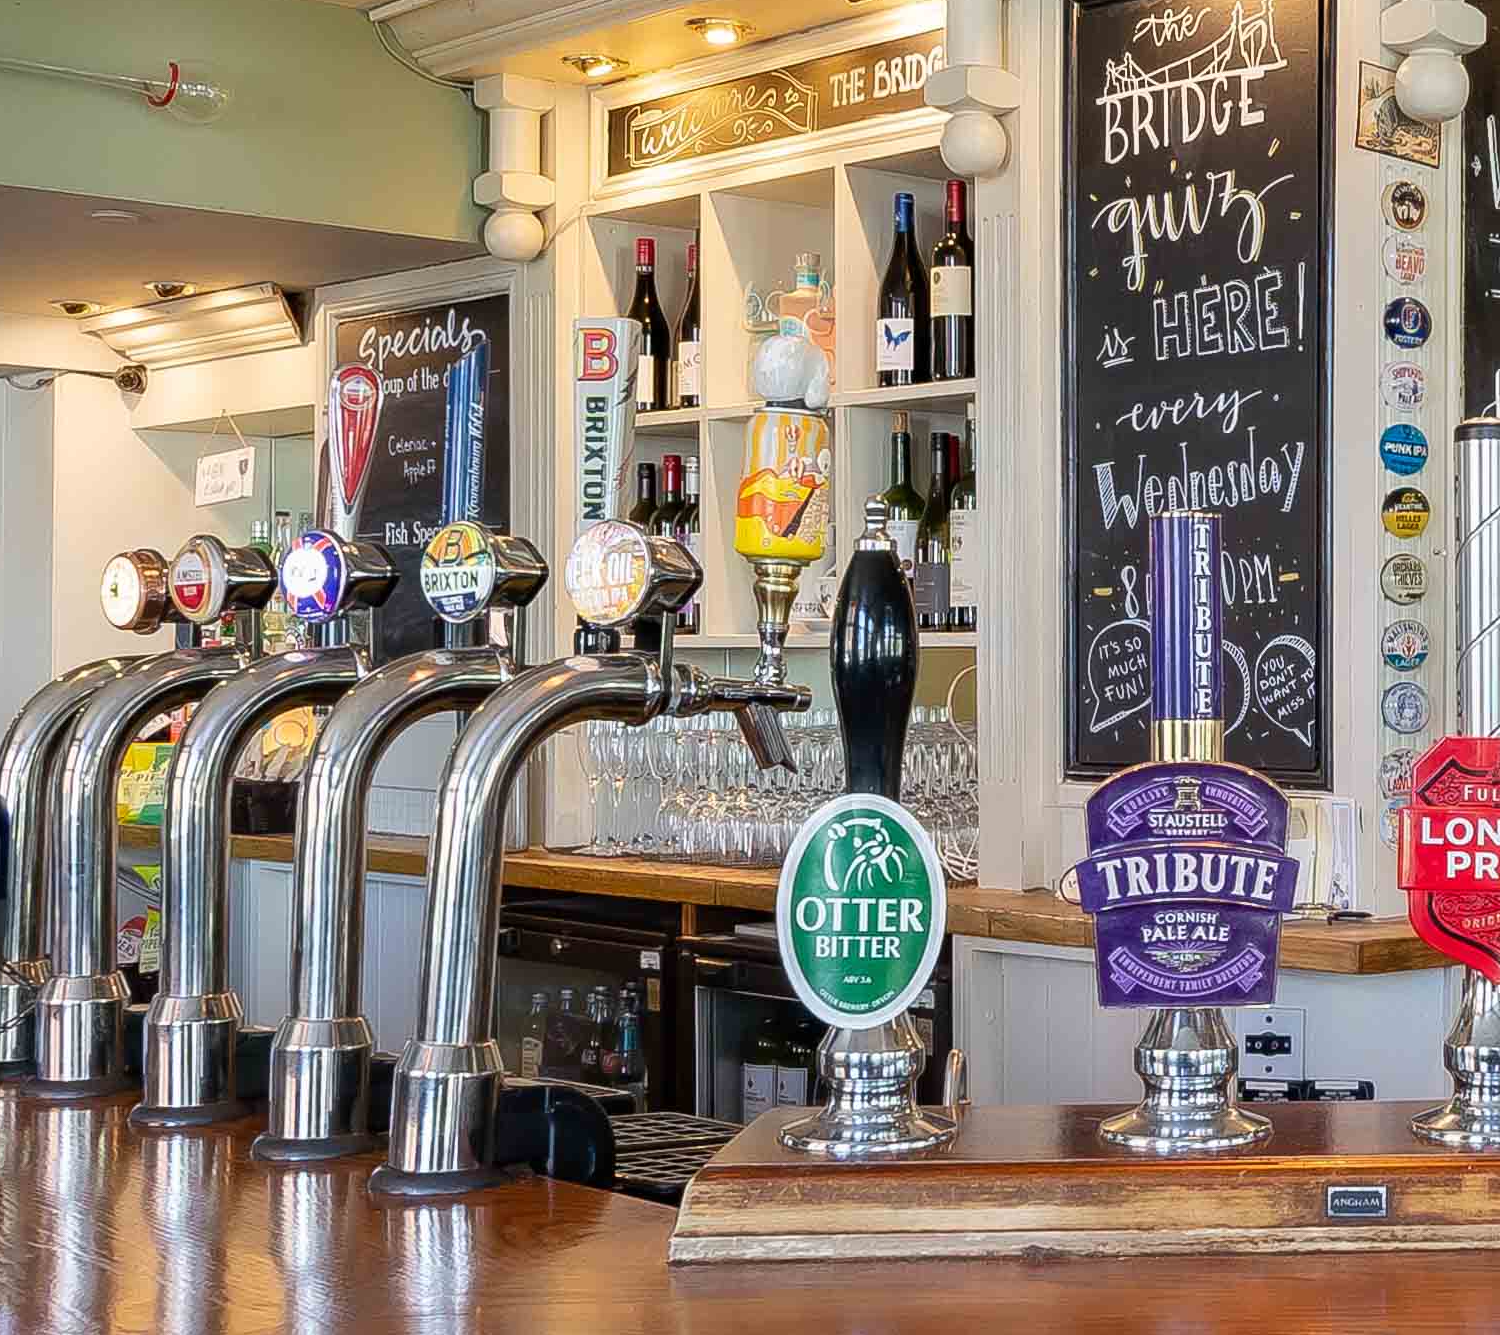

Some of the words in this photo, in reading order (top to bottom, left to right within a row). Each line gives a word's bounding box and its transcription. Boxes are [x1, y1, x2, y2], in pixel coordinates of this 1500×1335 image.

[1133, 6, 1212, 46] the
[828, 66, 865, 107] THE
[1103, 68, 1265, 164] BRIDGE
[1091, 169, 1294, 291] quiz
[359, 308, 487, 369] Specials
[1096, 333, 1137, 363] is
[407, 371, 419, 394] of
[421, 367, 439, 391] the
[1115, 388, 1264, 434] every
[582, 396, 608, 521] BRIXTON
[1384, 442, 1413, 455] PUNK
[1413, 443, 1428, 457] IPA
[403, 463, 425, 485] Apple
[1092, 426, 1306, 531] Wednesday
[385, 521, 408, 546] Fish
[425, 571, 478, 593] BRIXTON
[1393, 572, 1423, 587] THIEVES
[1194, 522, 1214, 716] TRIBUTE
[1098, 641, 1123, 662] IT'S
[1124, 638, 1144, 654] SO
[1107, 652, 1149, 677] MUCH
[1262, 655, 1284, 676] YOU
[1262, 679, 1296, 705] WANT
[1301, 668, 1313, 682] TO
[1278, 696, 1304, 721] MISS
[1123, 785, 1170, 813] QUALITY
[1205, 785, 1256, 818] INNOVATION
[1097, 853, 1279, 901] TRIBUTE
[796, 896, 924, 932] OTTER
[1155, 912, 1217, 925] CORNISH
[815, 935, 900, 958] BITTER
[1142, 926, 1187, 943] PALE
[1192, 925, 1230, 942] ALE
[843, 975, 860, 985] ABV
[1117, 952, 1178, 991] INDEPENDENT
[1180, 979, 1214, 991] FAMILY
